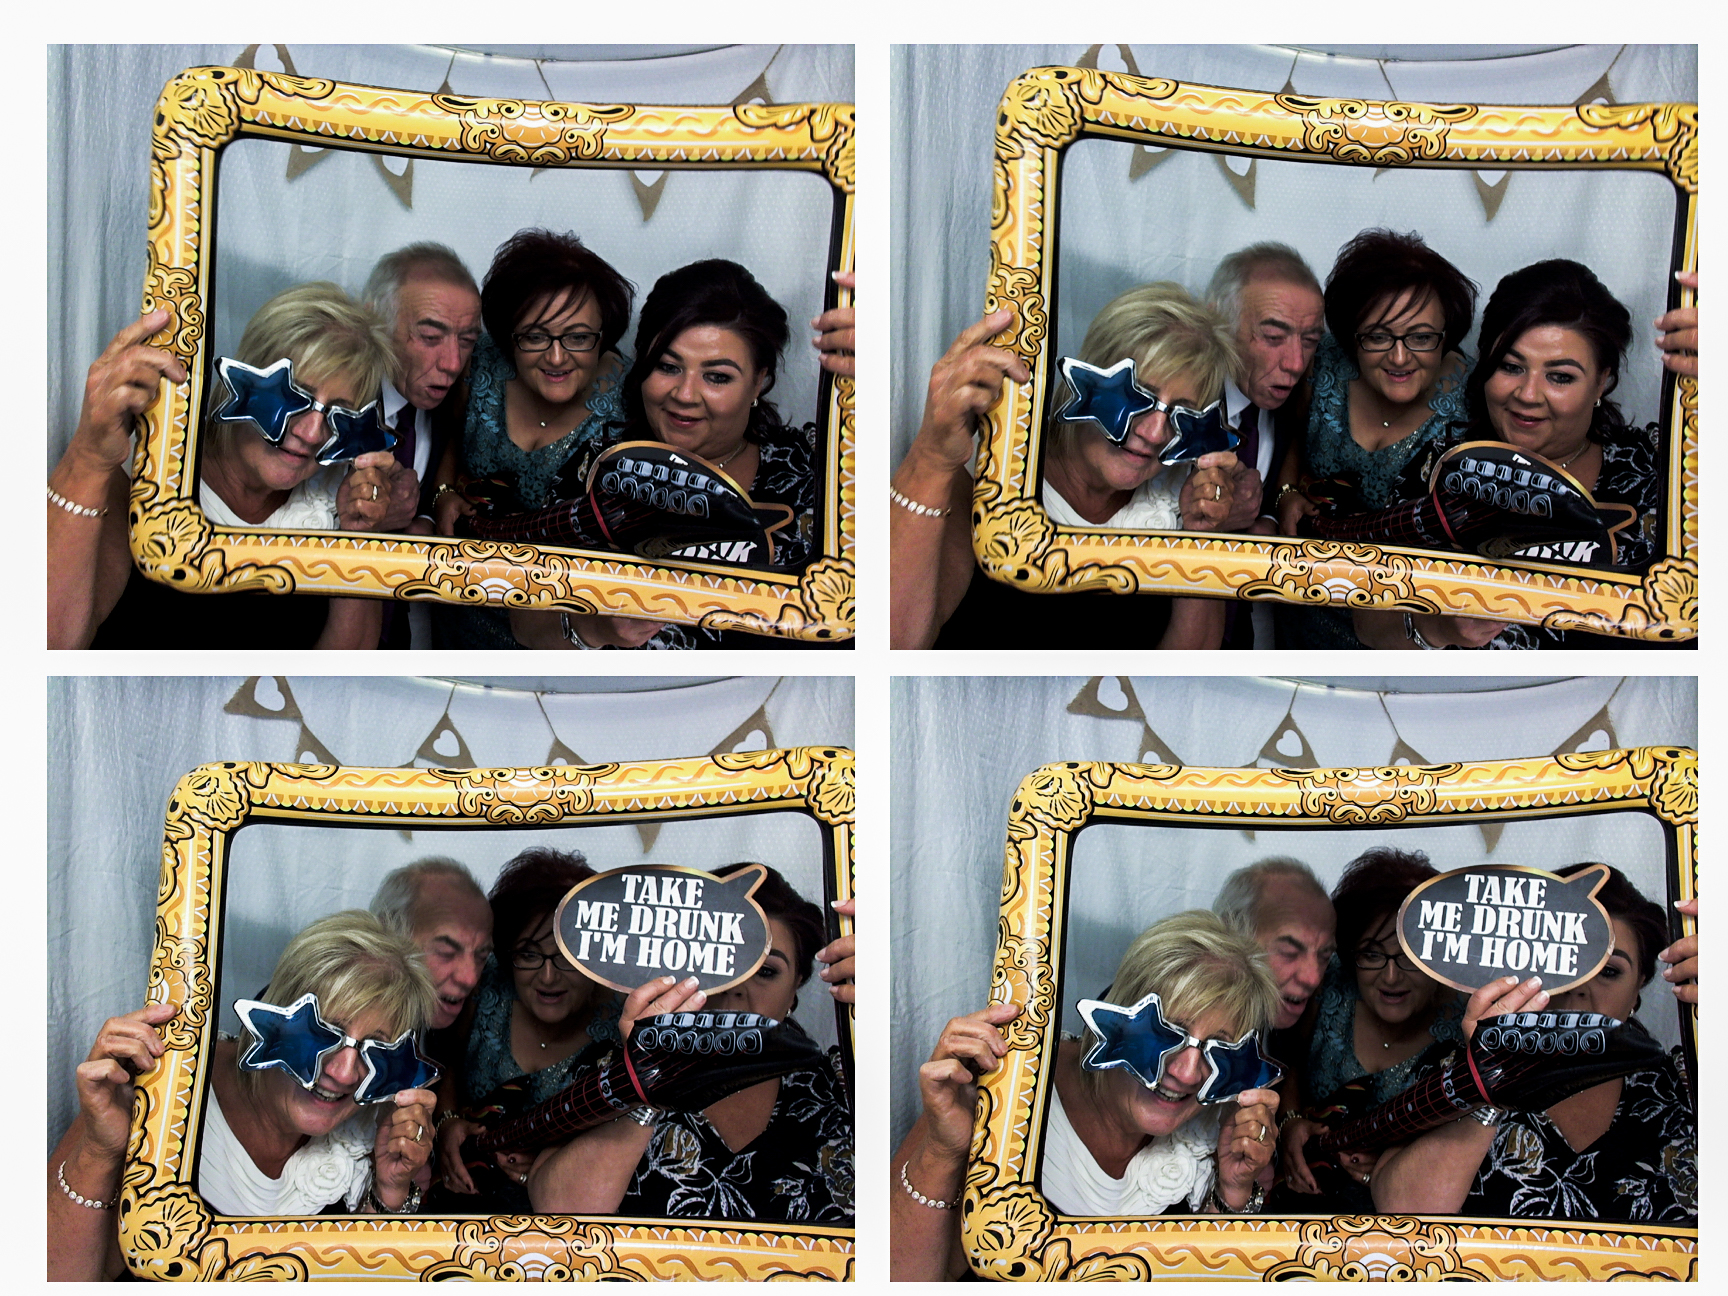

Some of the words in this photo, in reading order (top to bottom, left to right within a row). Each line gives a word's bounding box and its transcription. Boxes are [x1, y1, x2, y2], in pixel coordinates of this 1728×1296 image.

[621, 873, 705, 910] TAKE
[1464, 873, 1548, 910] TAKE
[574, 899, 621, 933] ME
[627, 904, 746, 945] DRUNK
[1417, 899, 1464, 933] ME
[1470, 904, 1589, 945] DRUNK
[576, 930, 629, 965] I'M
[635, 936, 737, 977] HOME
[1419, 930, 1472, 965] I'M
[1478, 936, 1580, 977] HOME
